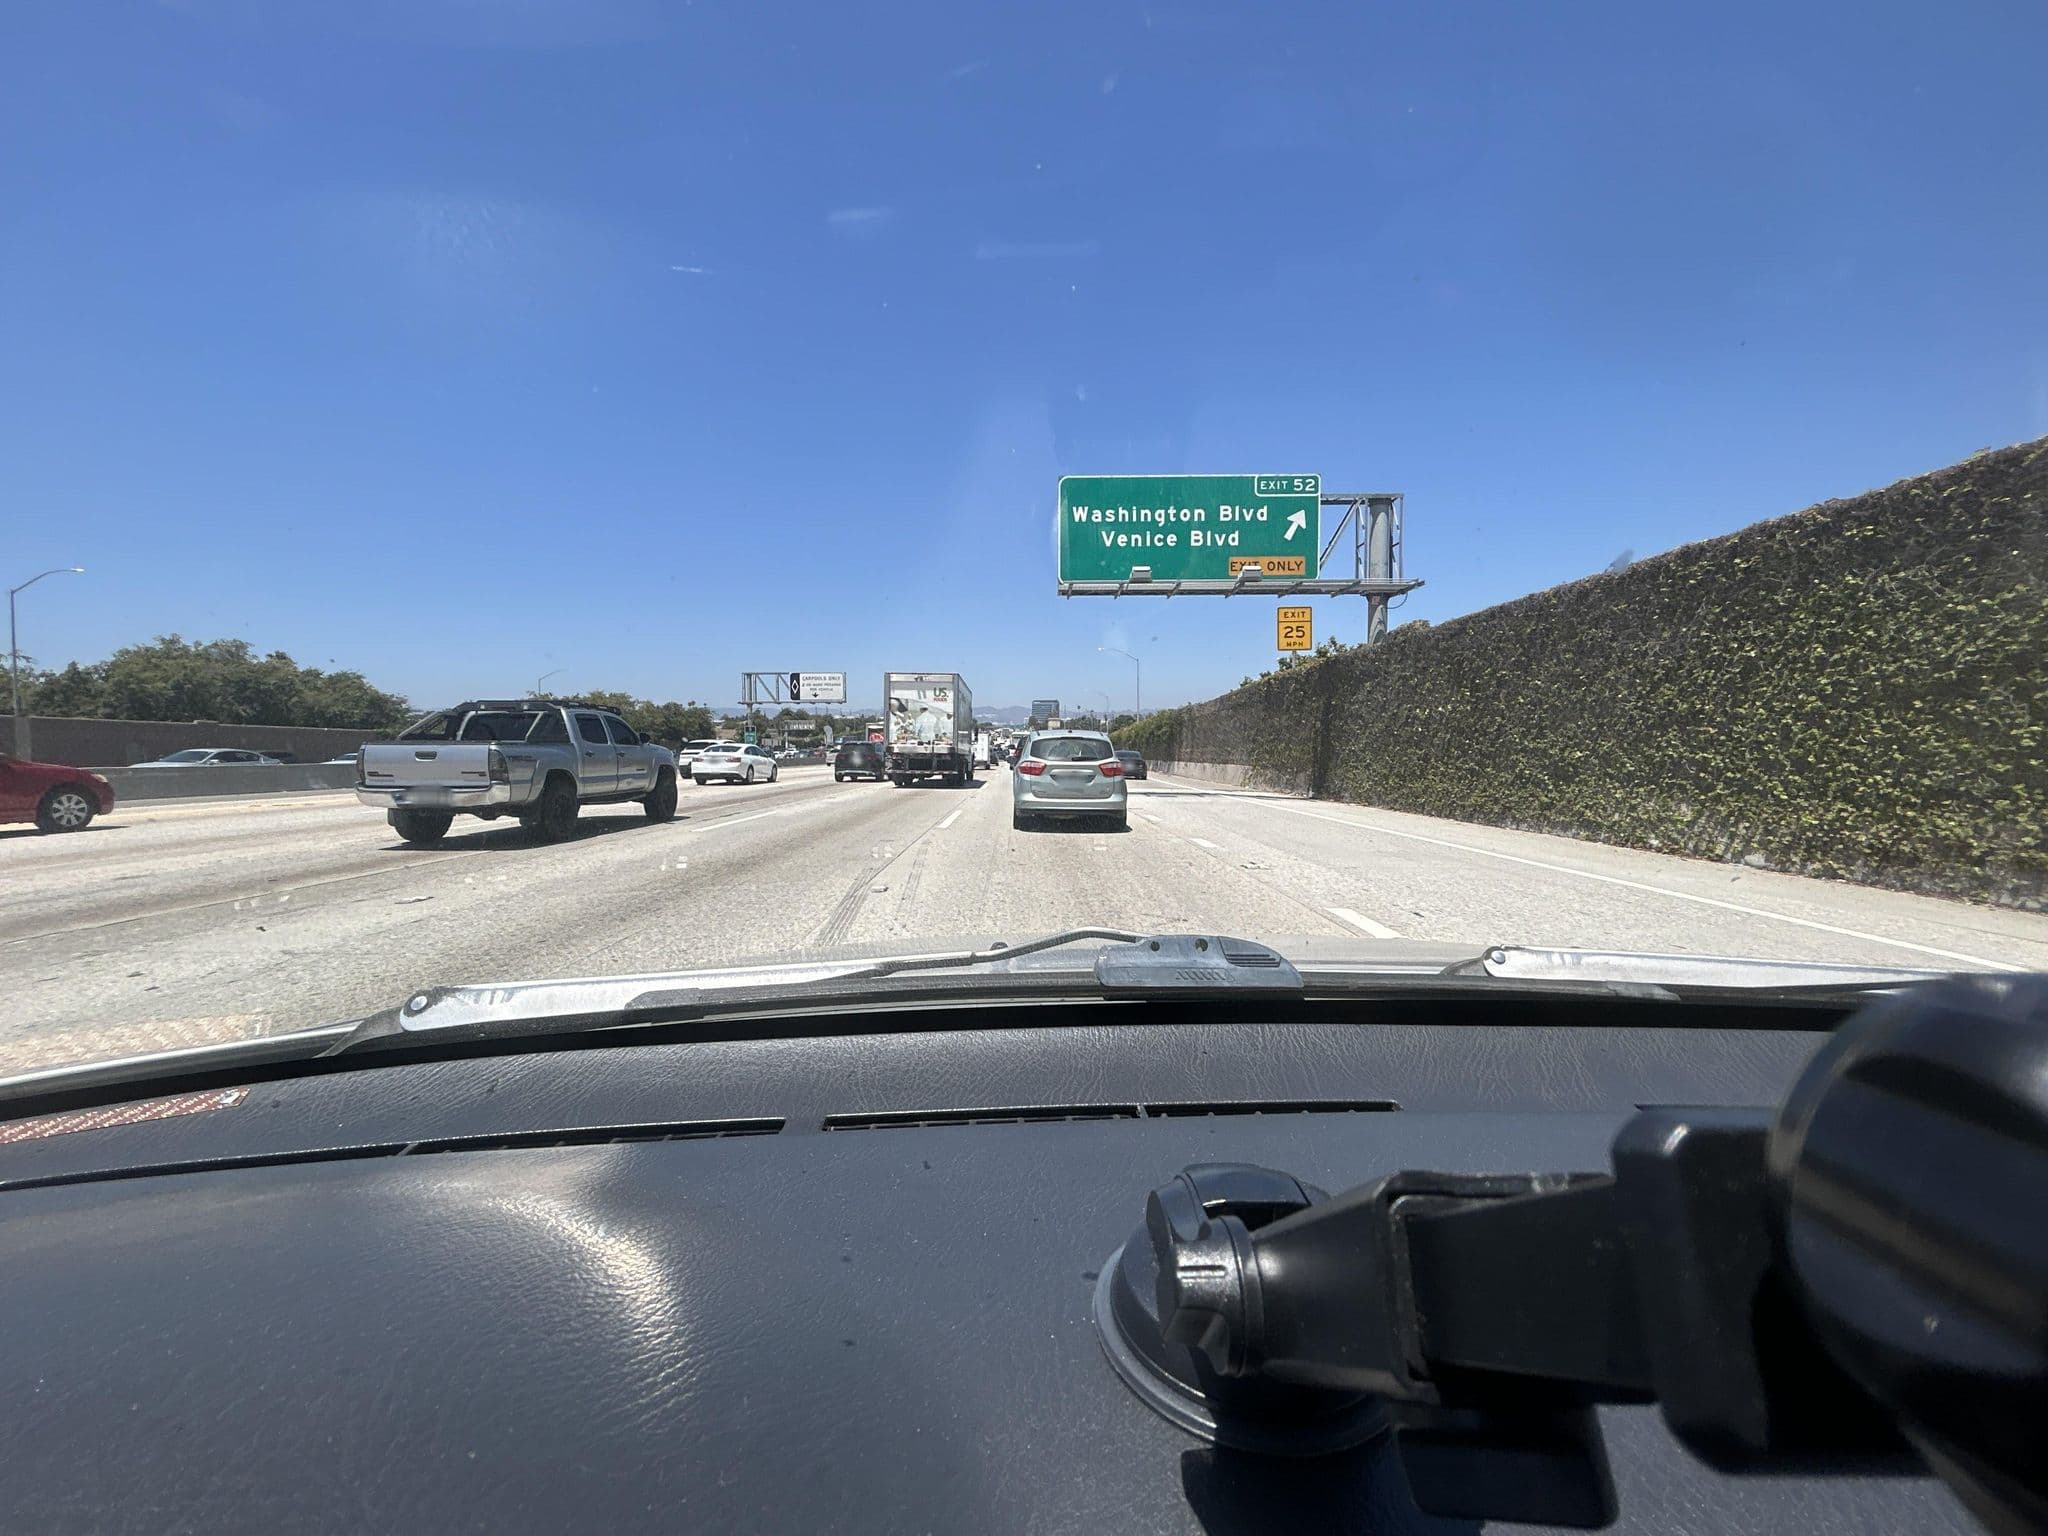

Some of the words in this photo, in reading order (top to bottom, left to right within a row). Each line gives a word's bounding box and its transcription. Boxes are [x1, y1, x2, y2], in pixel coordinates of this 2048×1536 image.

[1260, 481, 1288, 490] EXIT
[1293, 479, 1315, 491] 52
[1072, 506, 1206, 527] Washington
[1219, 505, 1268, 521] Blvd
[1101, 530, 1178, 547] Venice
[1190, 530, 1239, 546] Blvd
[1267, 561, 1303, 571] ONLY
[1283, 625, 1306, 639] 25
